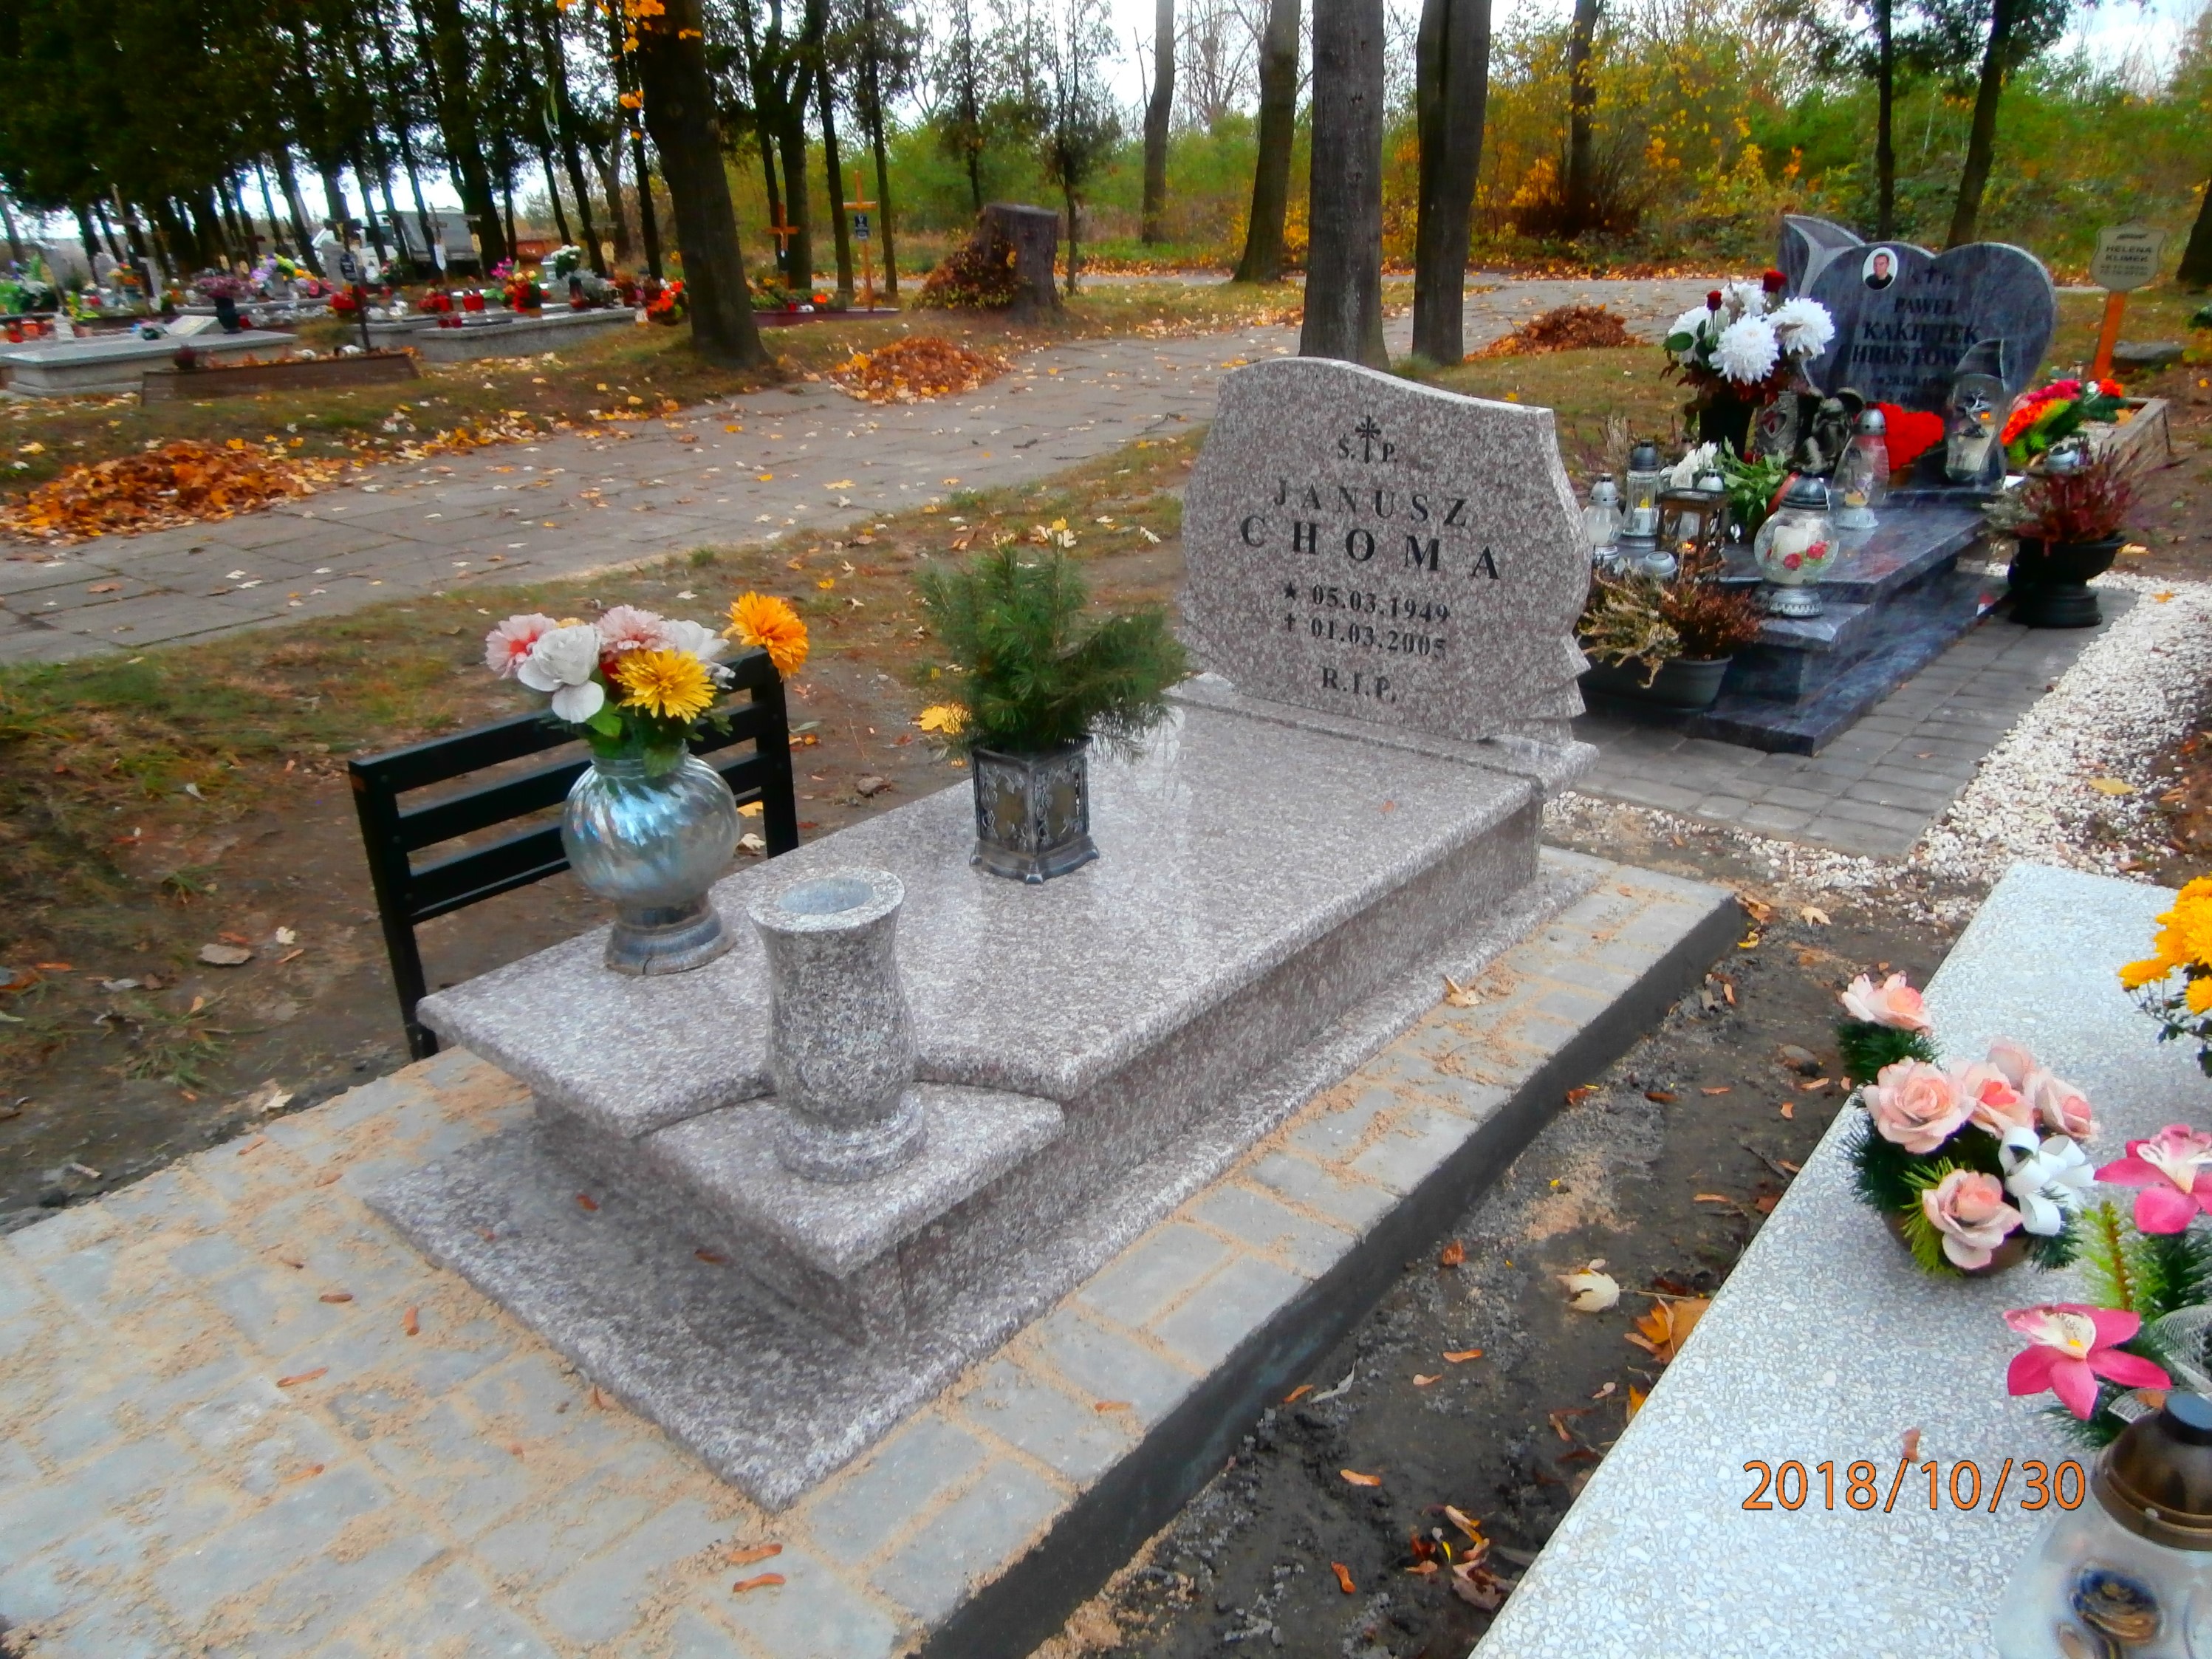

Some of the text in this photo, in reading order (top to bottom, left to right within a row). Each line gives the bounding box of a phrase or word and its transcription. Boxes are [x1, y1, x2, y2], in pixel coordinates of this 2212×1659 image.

[1382, 441, 1398, 464] P.
[1273, 479, 1468, 527] JANUSZ
[1240, 514, 1500, 580] CHOMA
[1312, 584, 1451, 623] 05.03.1949
[1310, 617, 1447, 659] 01.03.2005
[1321, 666, 1397, 703] R.I.P.
